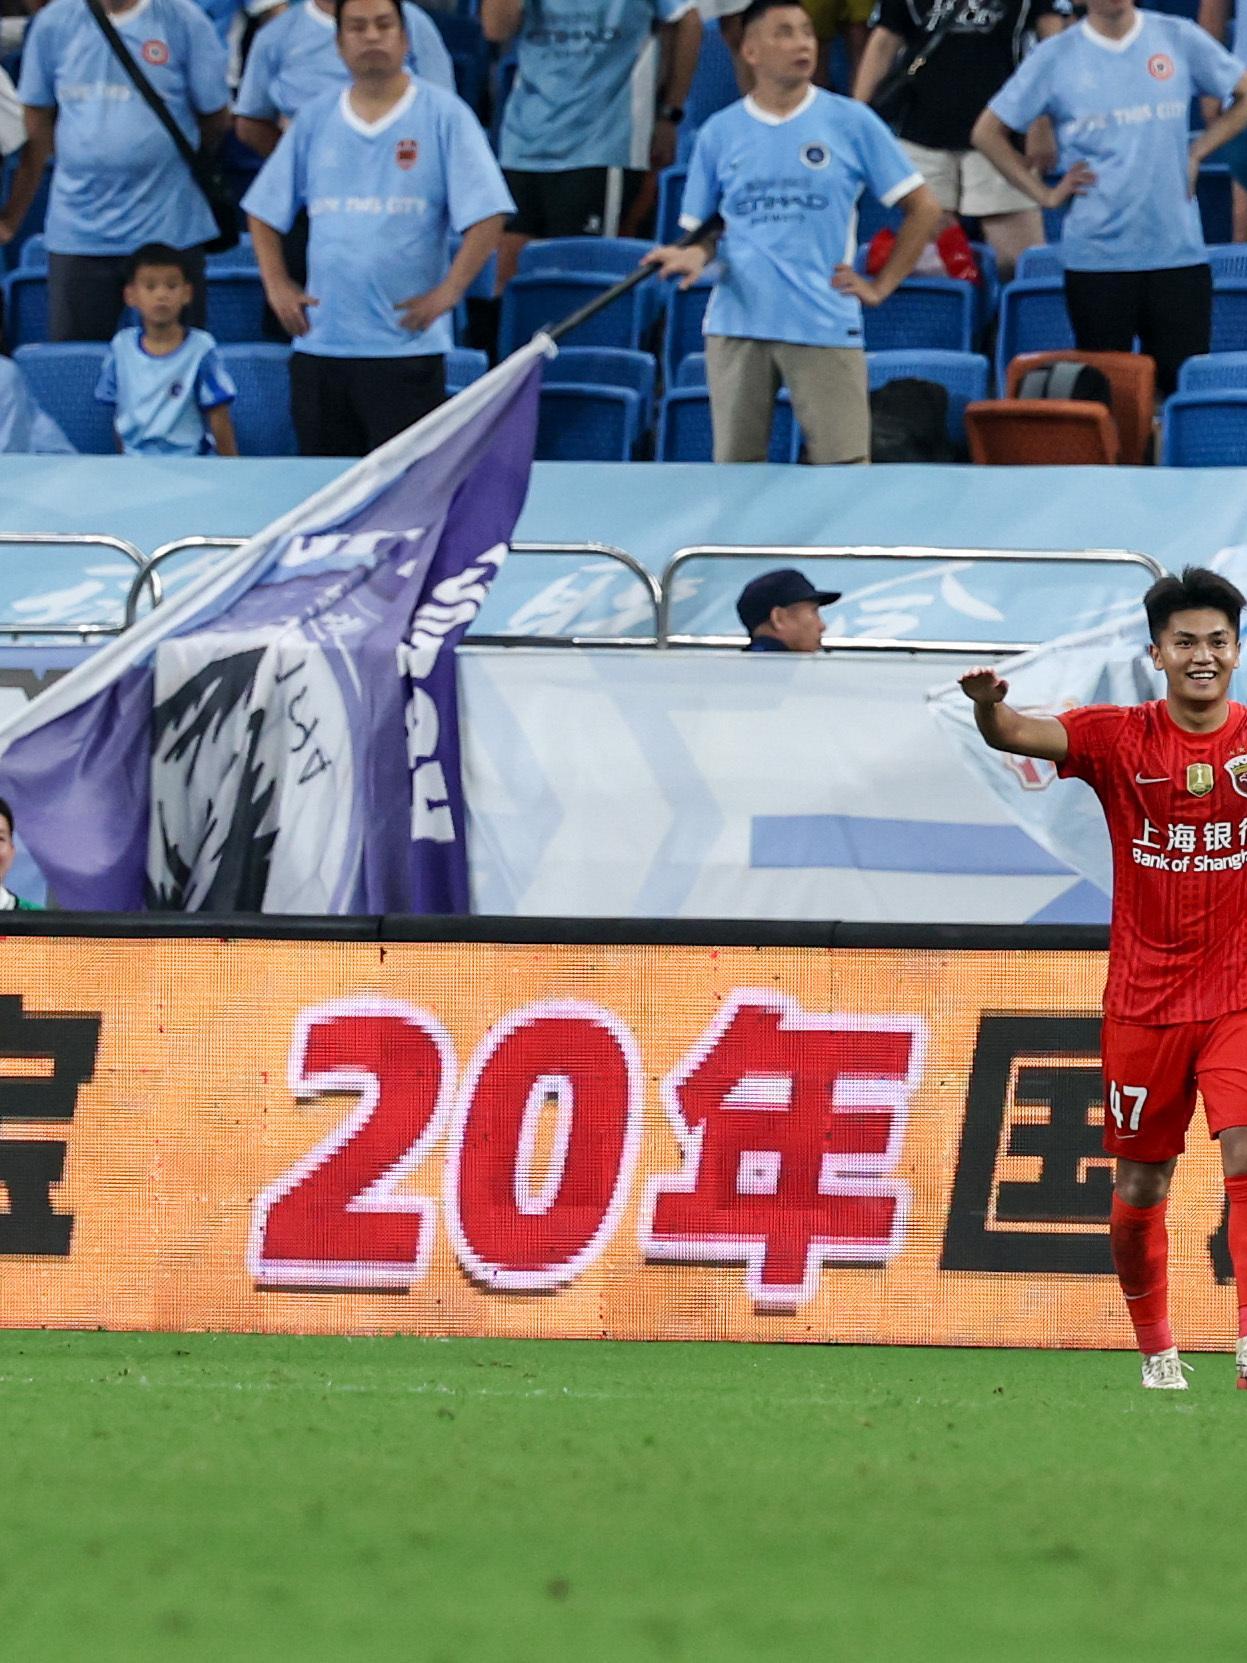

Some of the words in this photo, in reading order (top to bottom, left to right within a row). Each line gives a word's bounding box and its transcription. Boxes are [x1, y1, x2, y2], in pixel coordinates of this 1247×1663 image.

[1132, 847, 1169, 870] Bank
[1171, 856, 1190, 873] of
[1109, 1079, 1148, 1131] 47
[250, 989, 927, 1308] 20年
